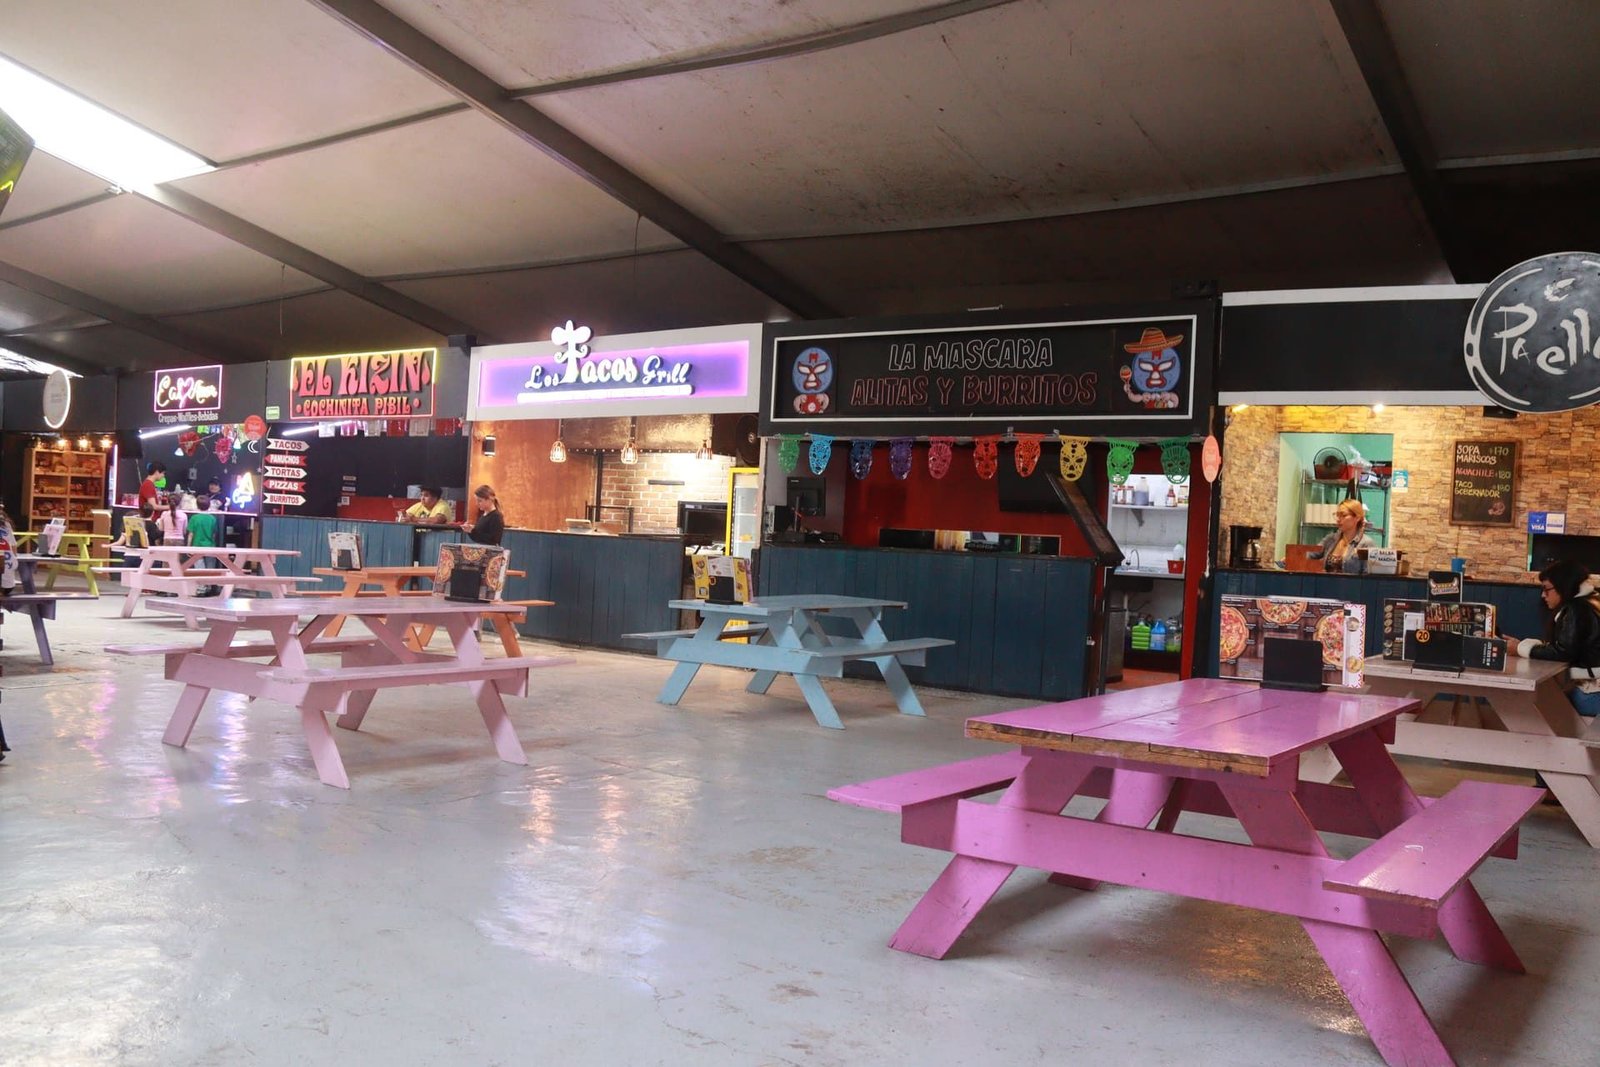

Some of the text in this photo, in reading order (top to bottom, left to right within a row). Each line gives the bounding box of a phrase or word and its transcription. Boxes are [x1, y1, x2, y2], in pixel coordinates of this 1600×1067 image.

[525, 320, 690, 389] Los Tacos Grill
[888, 338, 1053, 371] LA MASCARA
[299, 350, 425, 397] EL KIZIN
[850, 372, 1098, 407] ALITAS Y BURRITOS
[303, 396, 412, 416] COCHINITA PIBIL
[274, 440, 302, 450] TACOS
[1456, 445, 1481, 456] SOPA
[269, 454, 300, 464] PANUCHOS
[1456, 454, 1497, 465] MARISCOS
[271, 467, 301, 477] TORTAS
[269, 480, 299, 490] PIZZAS
[1455, 480, 1473, 489] TACO
[269, 494, 300, 504] BURRITOS
[1418, 631, 1428, 640] 20
